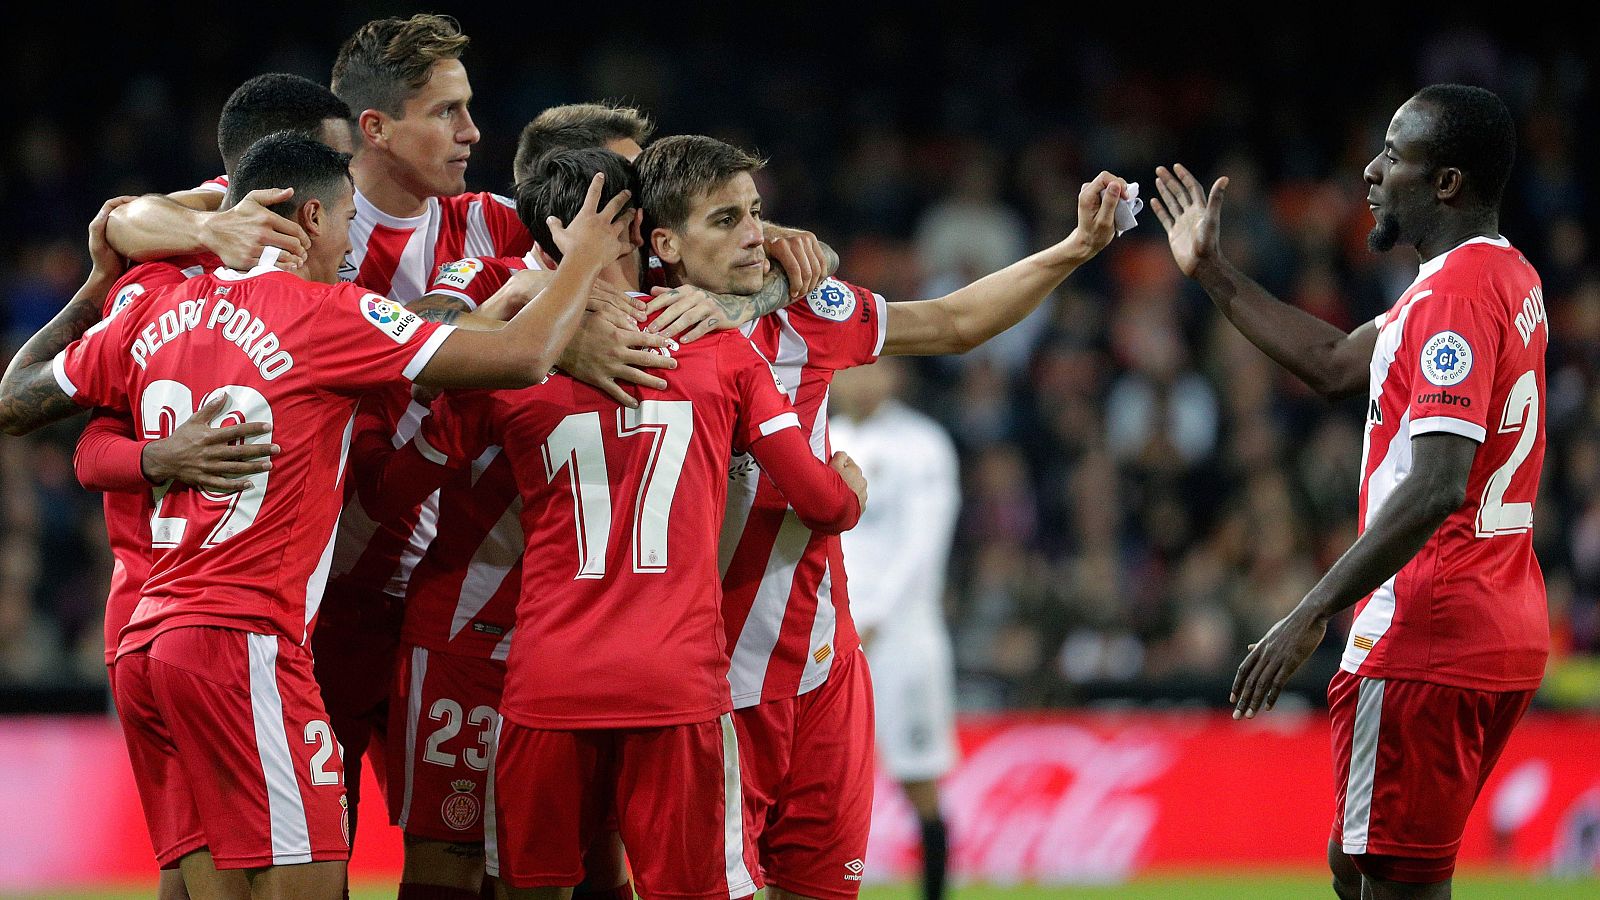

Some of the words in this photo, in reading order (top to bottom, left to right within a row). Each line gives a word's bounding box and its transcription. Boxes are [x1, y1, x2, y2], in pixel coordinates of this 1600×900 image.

[206, 298, 294, 381] PORRO
[1426, 337, 1446, 356] Costa
[1447, 335, 1467, 357] Brava
[1449, 361, 1467, 380] Girona
[1417, 390, 1472, 408] umbro
[541, 400, 694, 580] 17
[423, 698, 498, 771] 23
